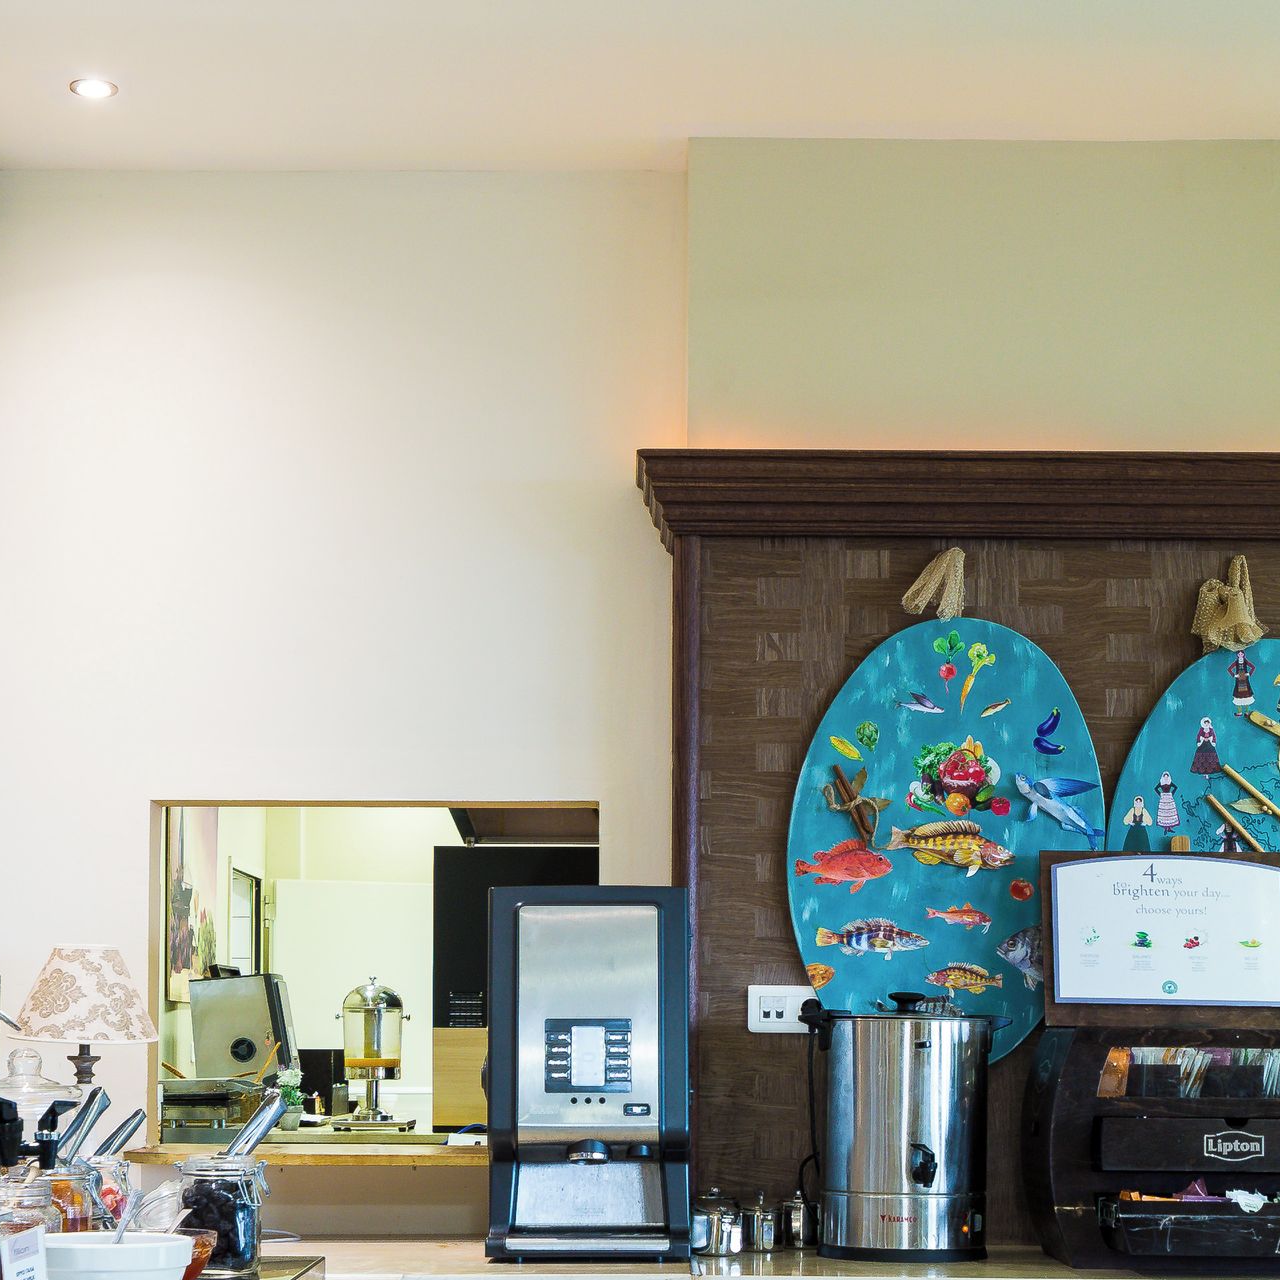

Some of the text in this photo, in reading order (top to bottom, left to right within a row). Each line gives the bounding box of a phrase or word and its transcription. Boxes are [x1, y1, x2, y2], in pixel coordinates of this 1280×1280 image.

[1142, 863, 1183, 888] 4 ways
[1113, 884, 1170, 900] brighten
[1173, 889, 1199, 900] your
[1135, 904, 1207, 917] choose yours!
[1208, 1138, 1260, 1155] Lipton
